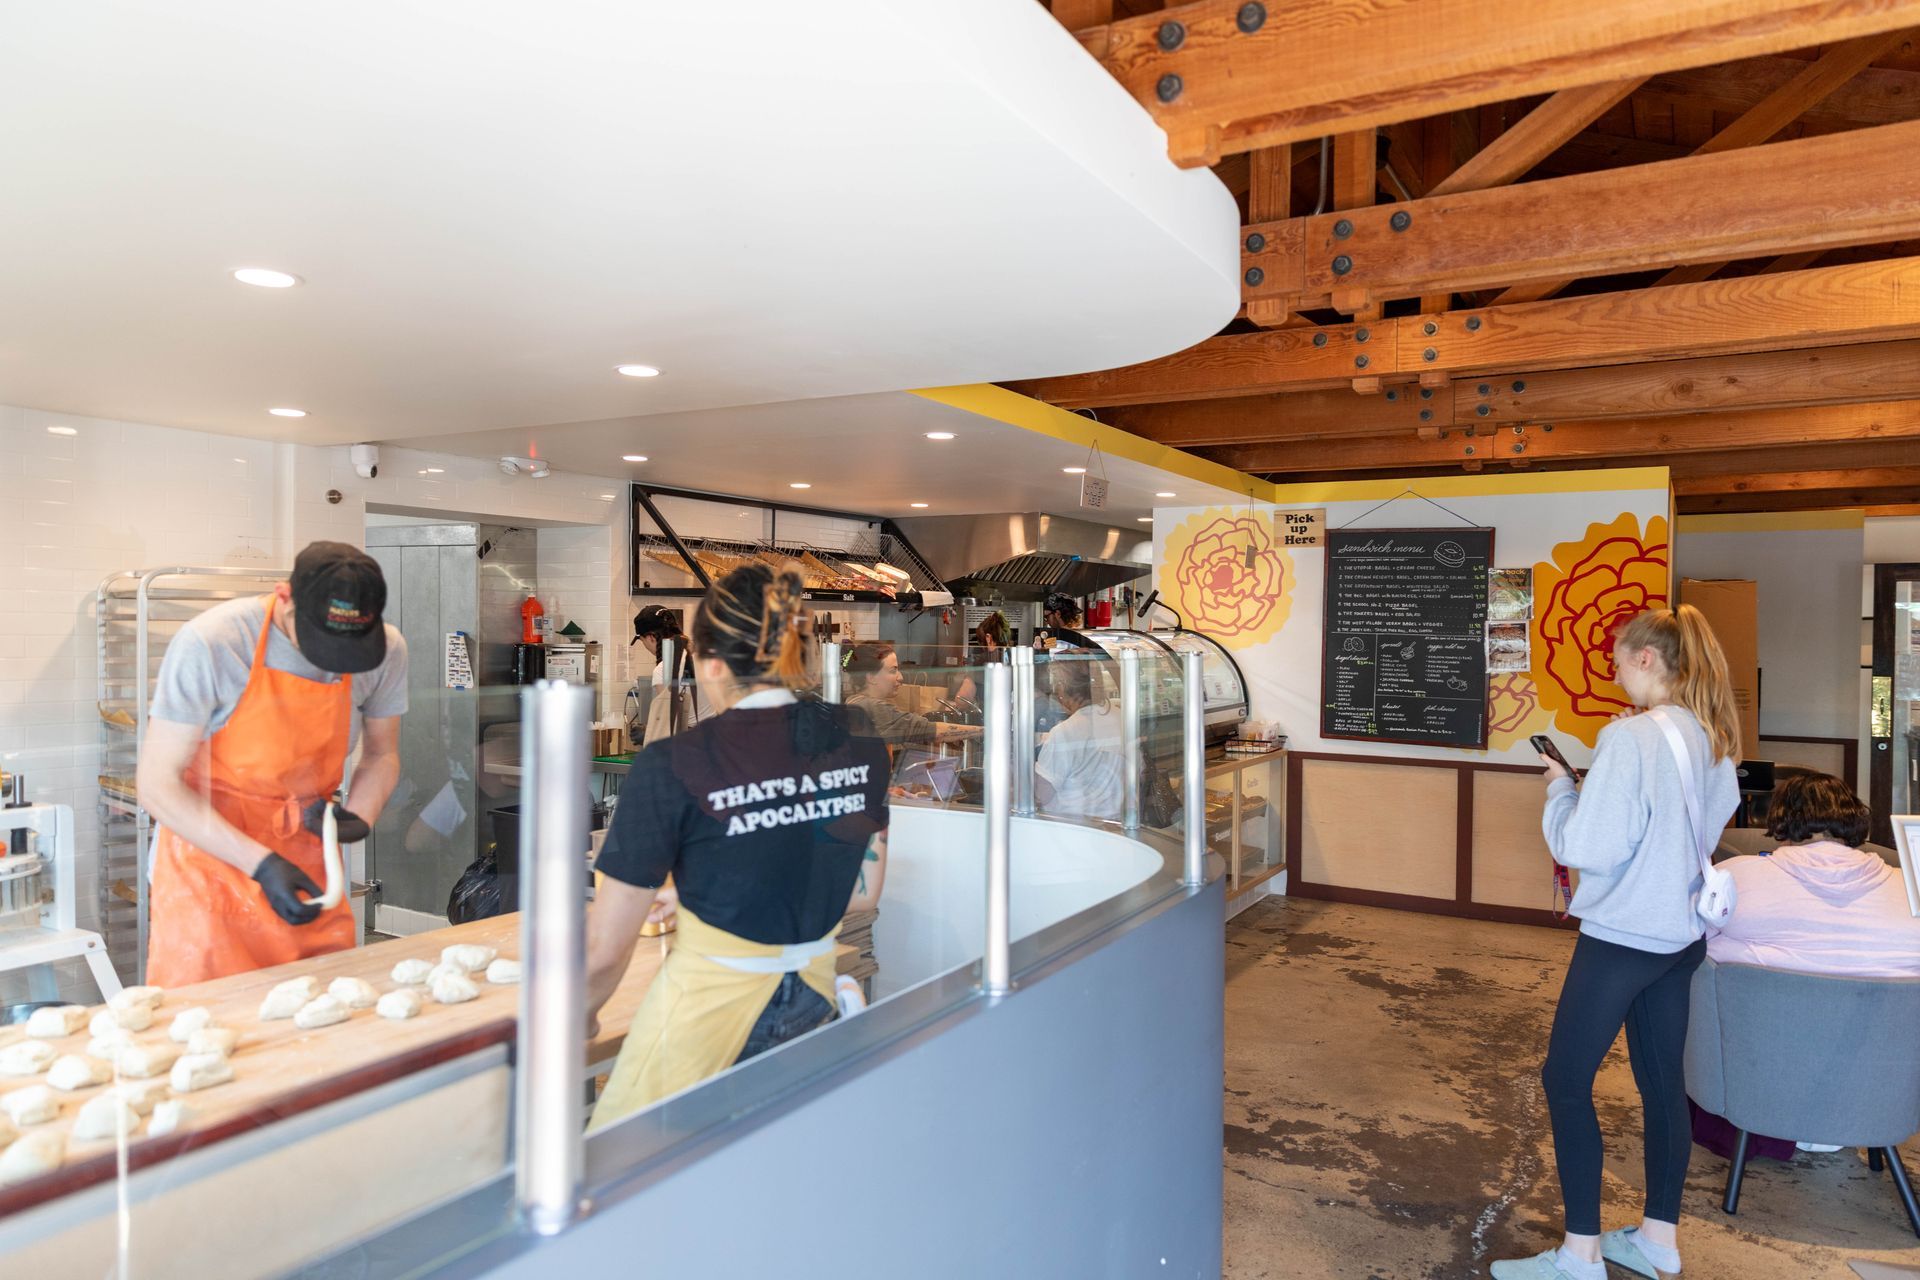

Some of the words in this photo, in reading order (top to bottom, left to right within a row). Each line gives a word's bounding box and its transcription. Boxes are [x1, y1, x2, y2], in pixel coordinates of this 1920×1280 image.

[1285, 514, 1315, 524] Pick
[1290, 525, 1308, 535] up
[1284, 535, 1316, 545] Here
[1337, 539, 1393, 554] sandwich
[1393, 546, 1426, 554] menu
[708, 777, 797, 811] THAT'S
[800, 774, 818, 794] A
[819, 765, 870, 791] SPICY
[726, 793, 866, 837] APOCALYPSE!
